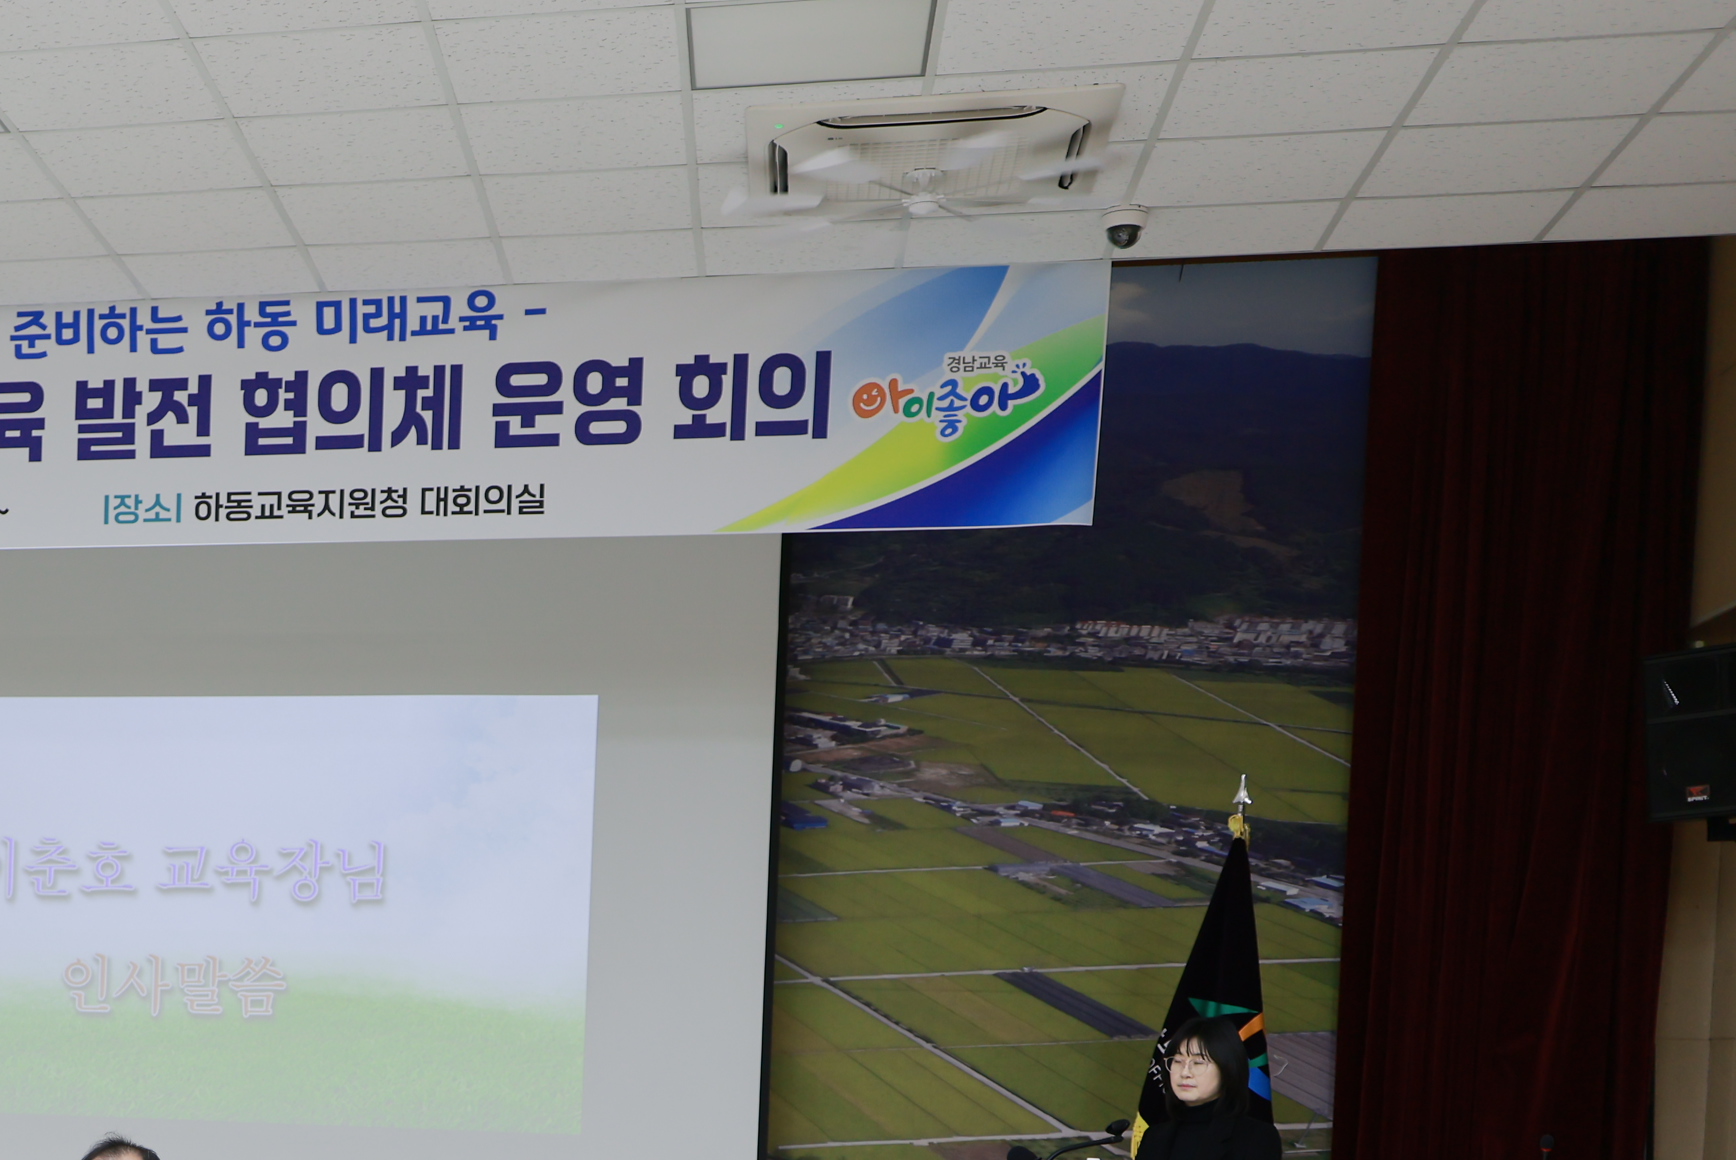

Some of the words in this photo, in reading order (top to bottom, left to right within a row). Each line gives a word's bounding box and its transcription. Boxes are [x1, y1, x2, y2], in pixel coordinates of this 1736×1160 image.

[9, 305, 189, 361] 준비하는
[204, 300, 298, 353] 하동
[315, 289, 505, 345] 미래교육
[946, 354, 1009, 373] 경남교육
[74, 375, 213, 462] 발전
[240, 364, 464, 458] 협의체
[492, 356, 644, 449] 운영
[672, 349, 833, 442] 회의
[852, 370, 1041, 438] 아이좋아
[194, 485, 408, 523] 하동교육지원청
[420, 483, 546, 518] 대회의실
[156, 837, 388, 906] 교육장님
[62, 951, 288, 1019] 인사말씀
